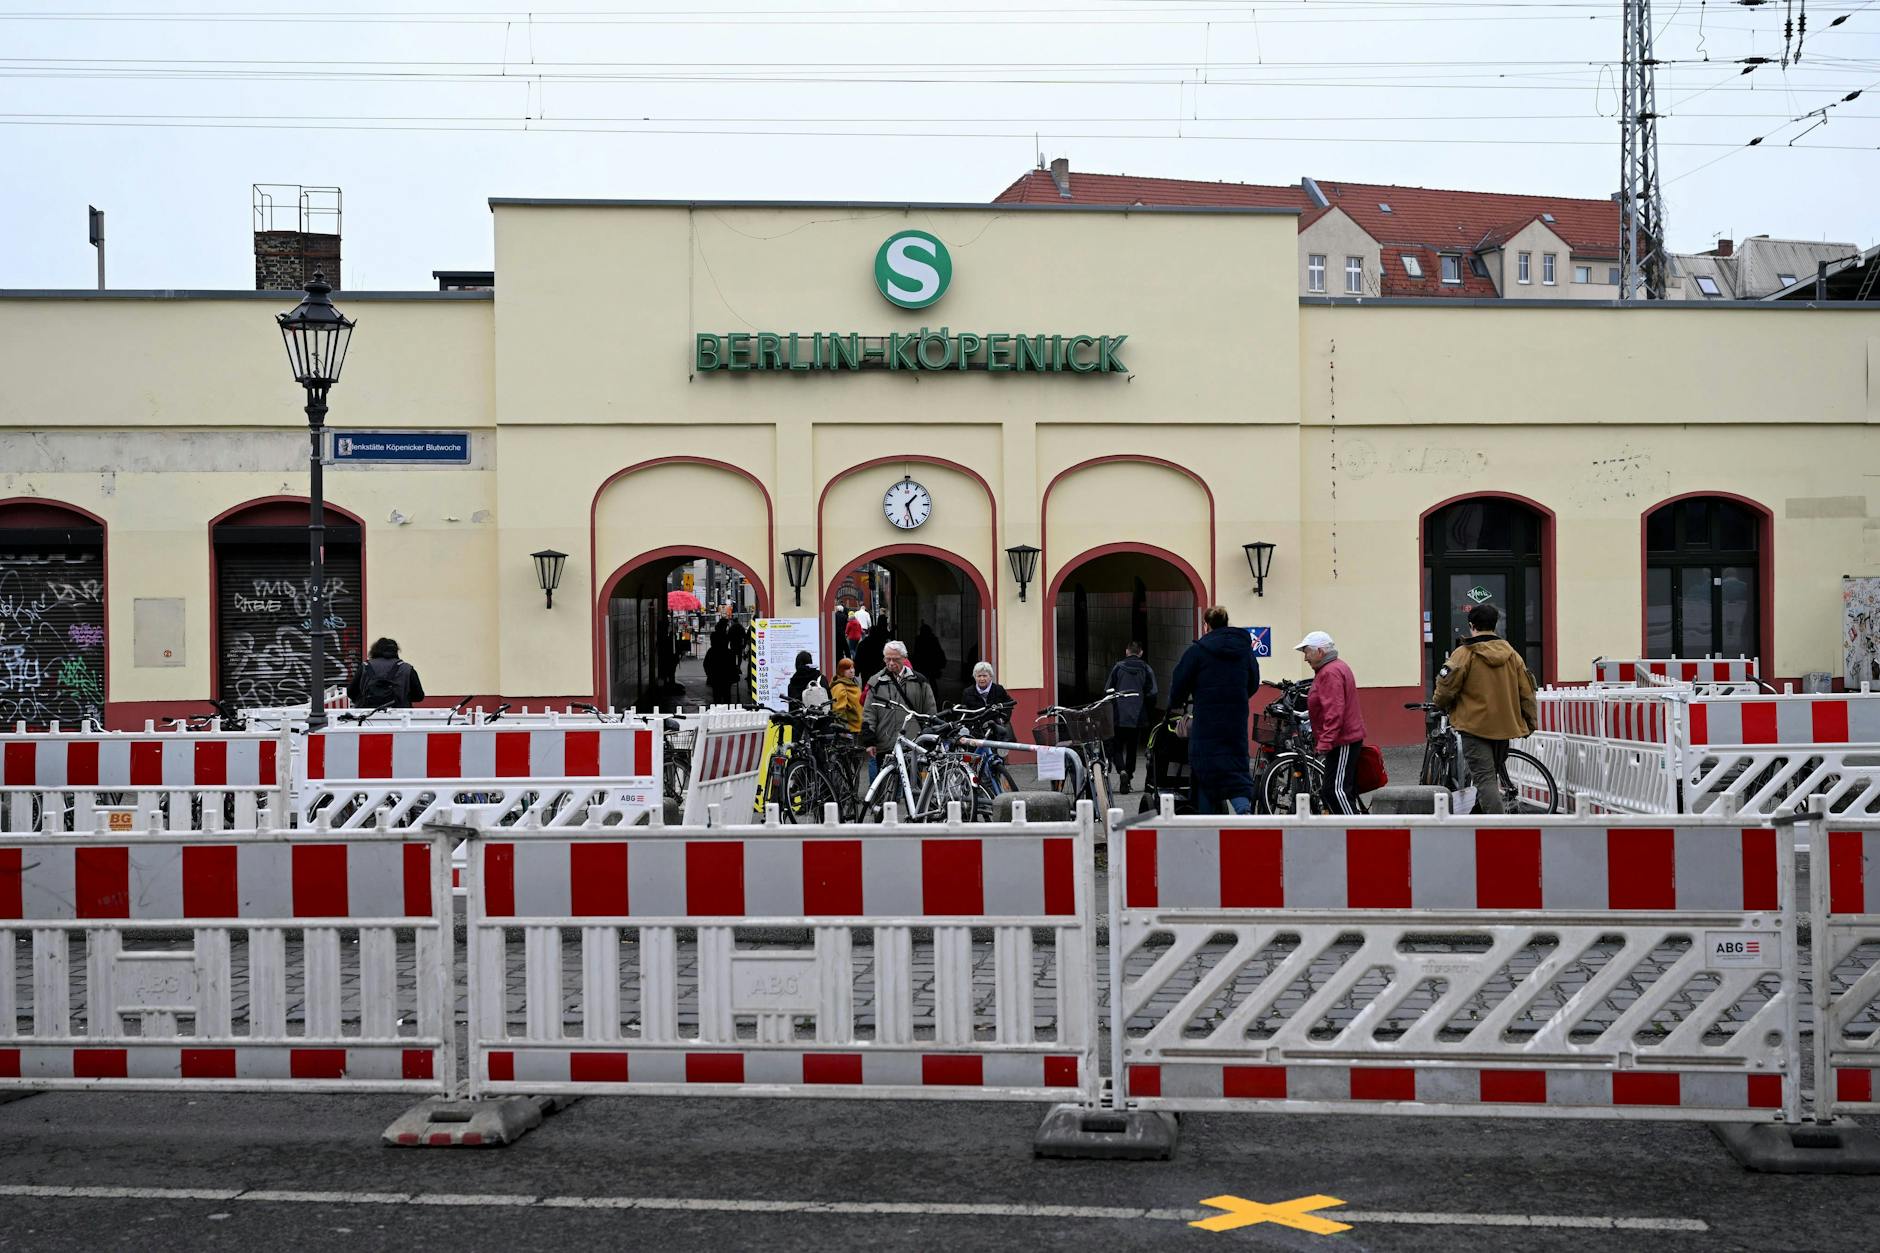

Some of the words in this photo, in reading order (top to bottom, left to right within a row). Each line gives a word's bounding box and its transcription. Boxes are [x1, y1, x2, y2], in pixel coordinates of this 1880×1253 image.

[886, 236, 940, 303] S
[695, 326, 1130, 374] BERLIN-KÖPENICK
[386, 443, 425, 453] Köpenicker
[425, 443, 461, 451] Blutwoche
[110, 813, 131, 824] BG
[1716, 942, 1744, 953] ABG
